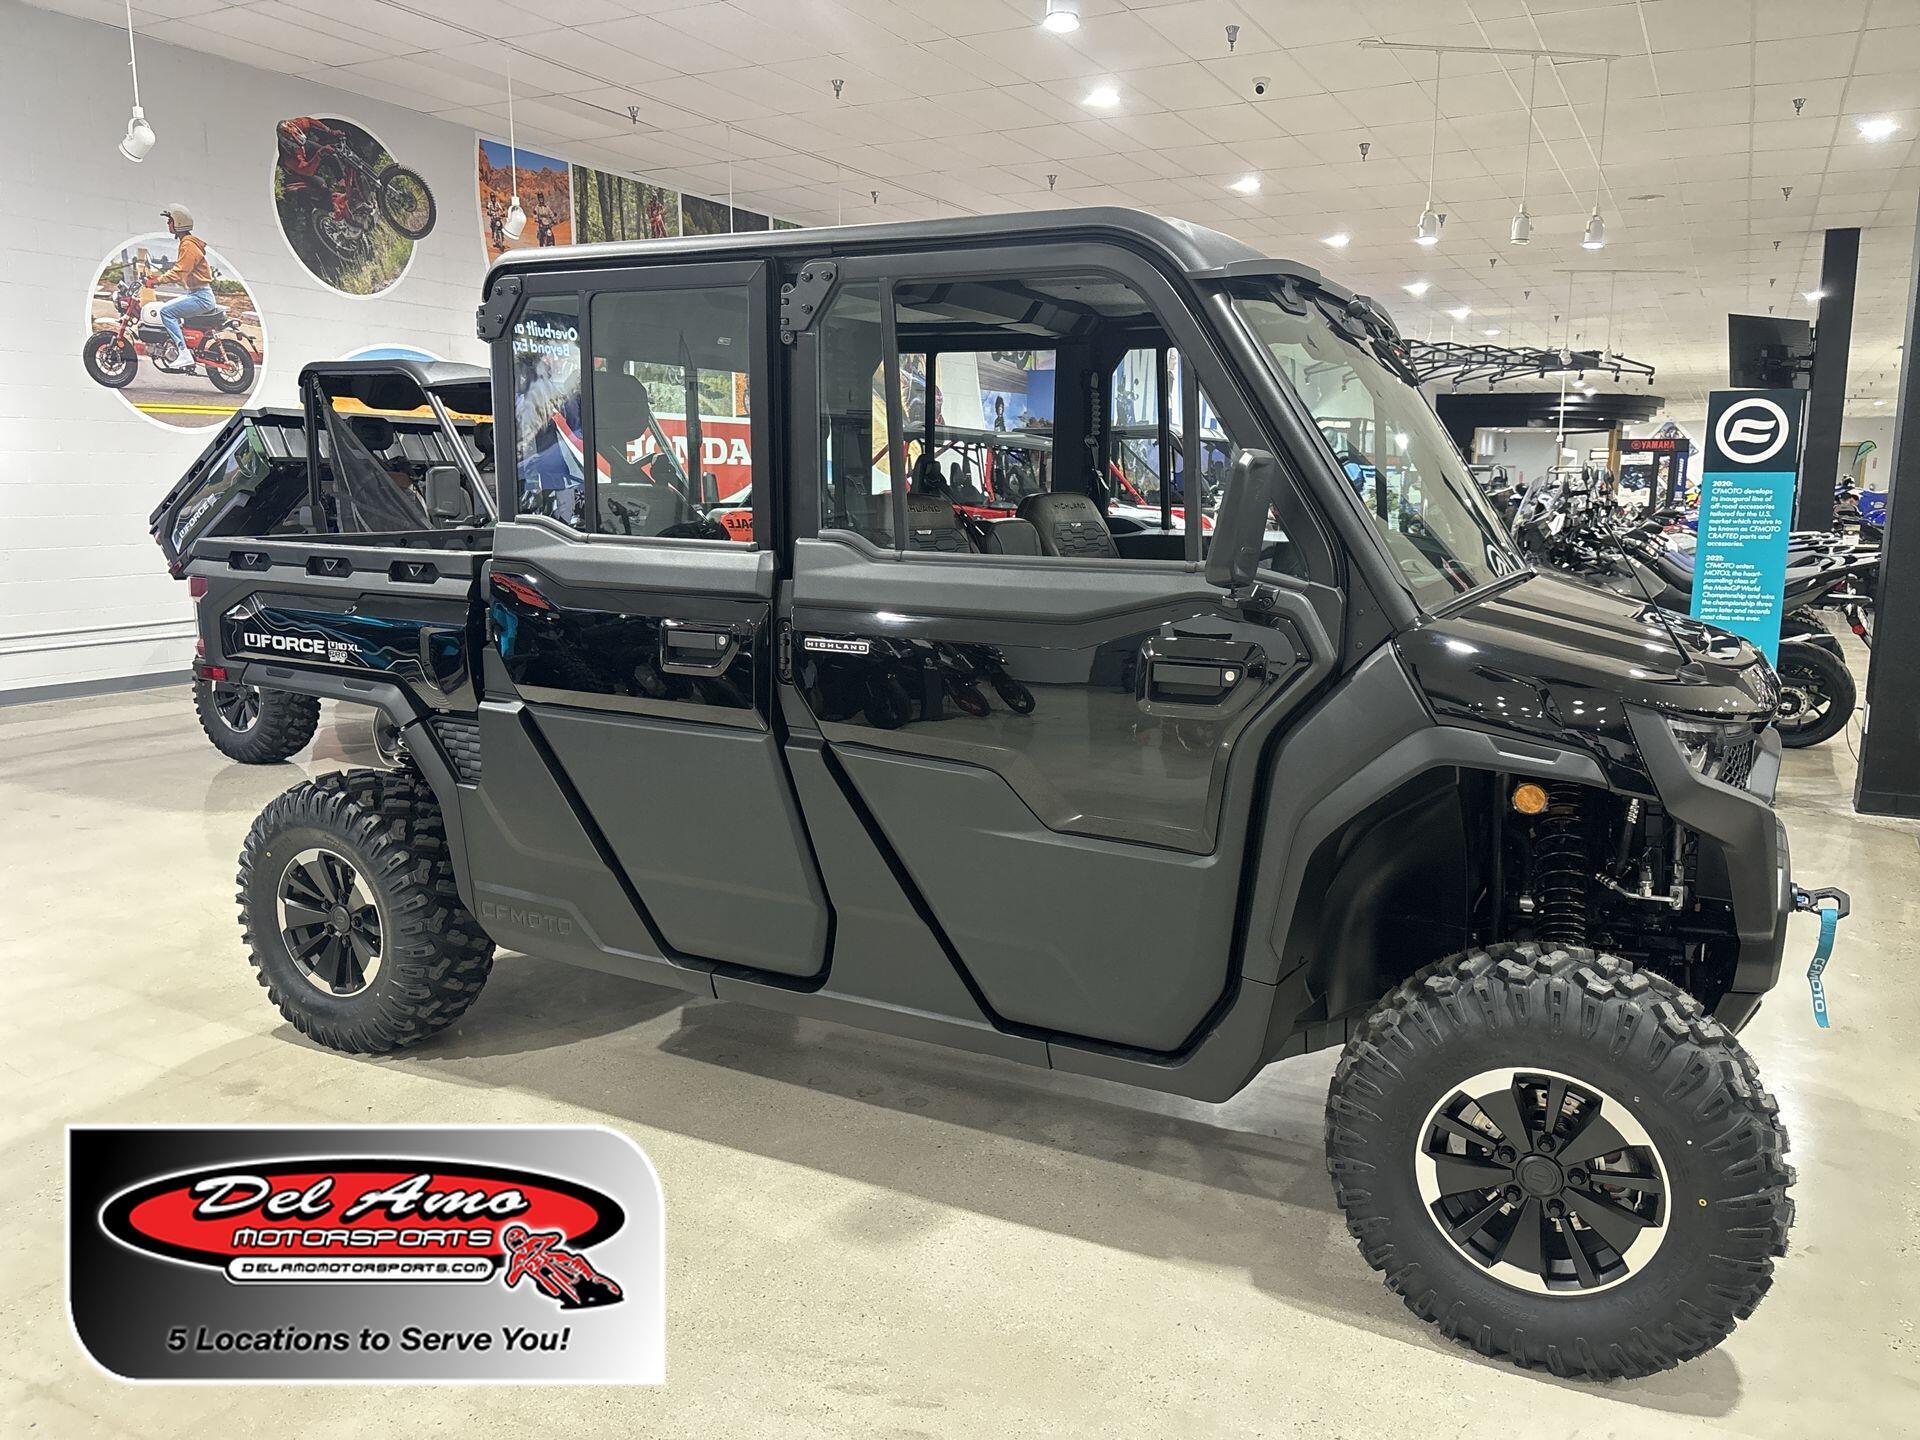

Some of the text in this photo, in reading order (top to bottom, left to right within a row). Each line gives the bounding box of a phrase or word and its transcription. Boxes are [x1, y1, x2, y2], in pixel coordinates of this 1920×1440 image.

[1641, 440, 1675, 449] YAMAHA
[1744, 488, 1773, 496] develops
[1703, 577, 1733, 585] pounding
[1713, 584, 1741, 592] MotoGP
[1702, 591, 1746, 600] Championship
[1712, 599, 1756, 608] championship
[806, 641, 866, 651] HIGHLAND
[481, 901, 572, 936] CFMOTO
[1809, 957, 1825, 1013] CFMOTO
